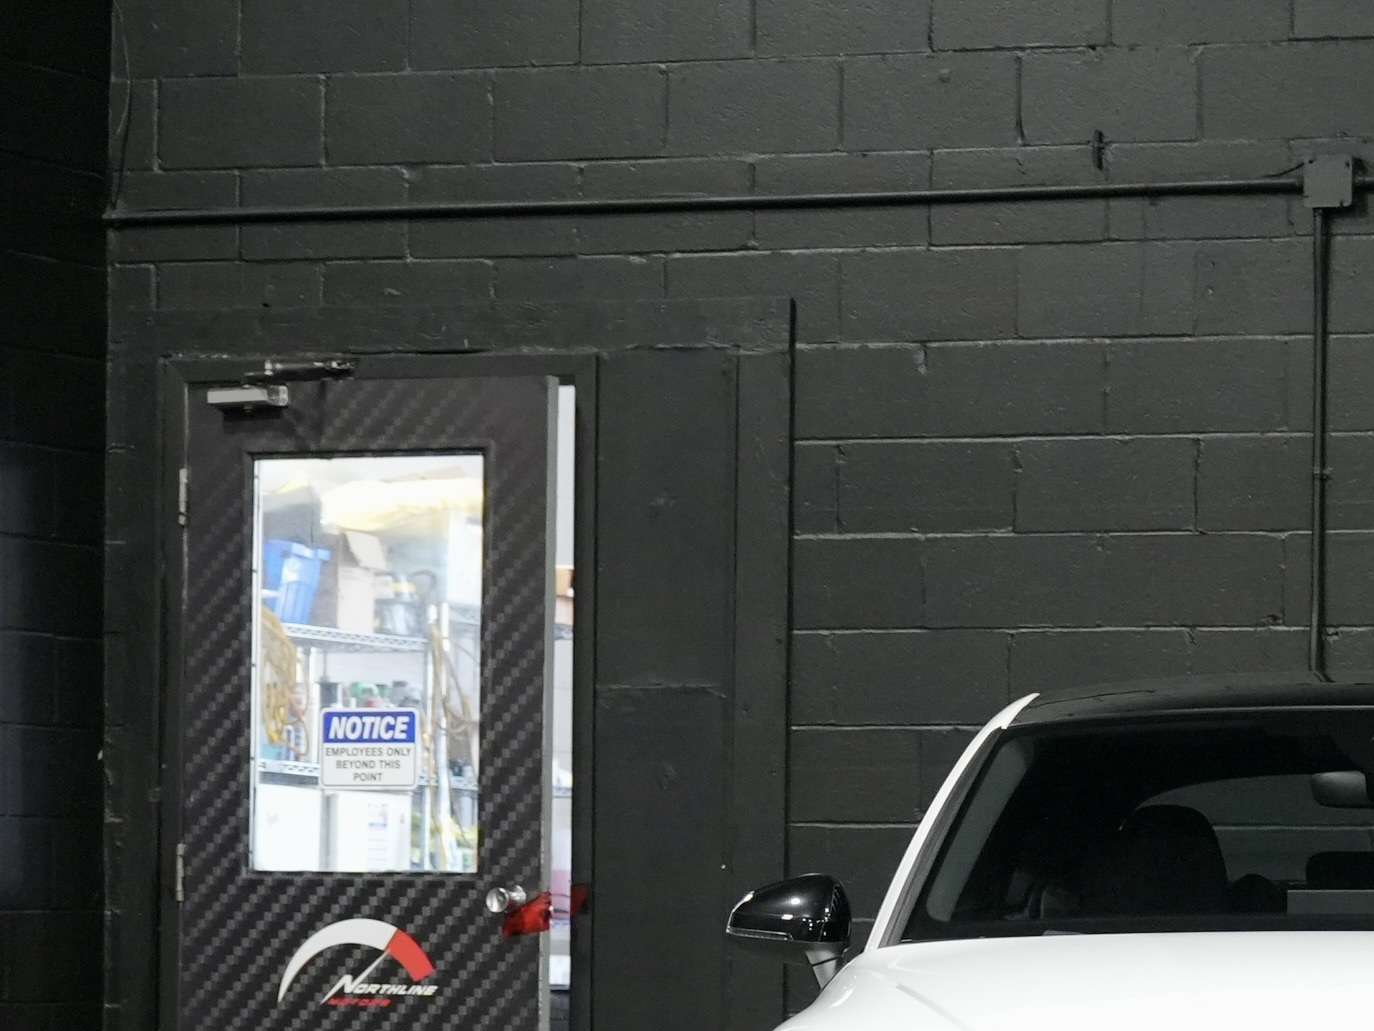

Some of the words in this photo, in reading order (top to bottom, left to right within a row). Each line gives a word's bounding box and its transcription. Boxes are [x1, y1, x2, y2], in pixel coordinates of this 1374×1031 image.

[328, 715, 410, 740] NOTICE
[325, 747, 384, 757] EMPLOYEES
[386, 747, 411, 757] ONLY
[336, 760, 376, 769] BEYOND
[379, 760, 401, 769] THIS
[353, 772, 382, 782] POINT
[320, 974, 439, 1005] NORTHLINE
